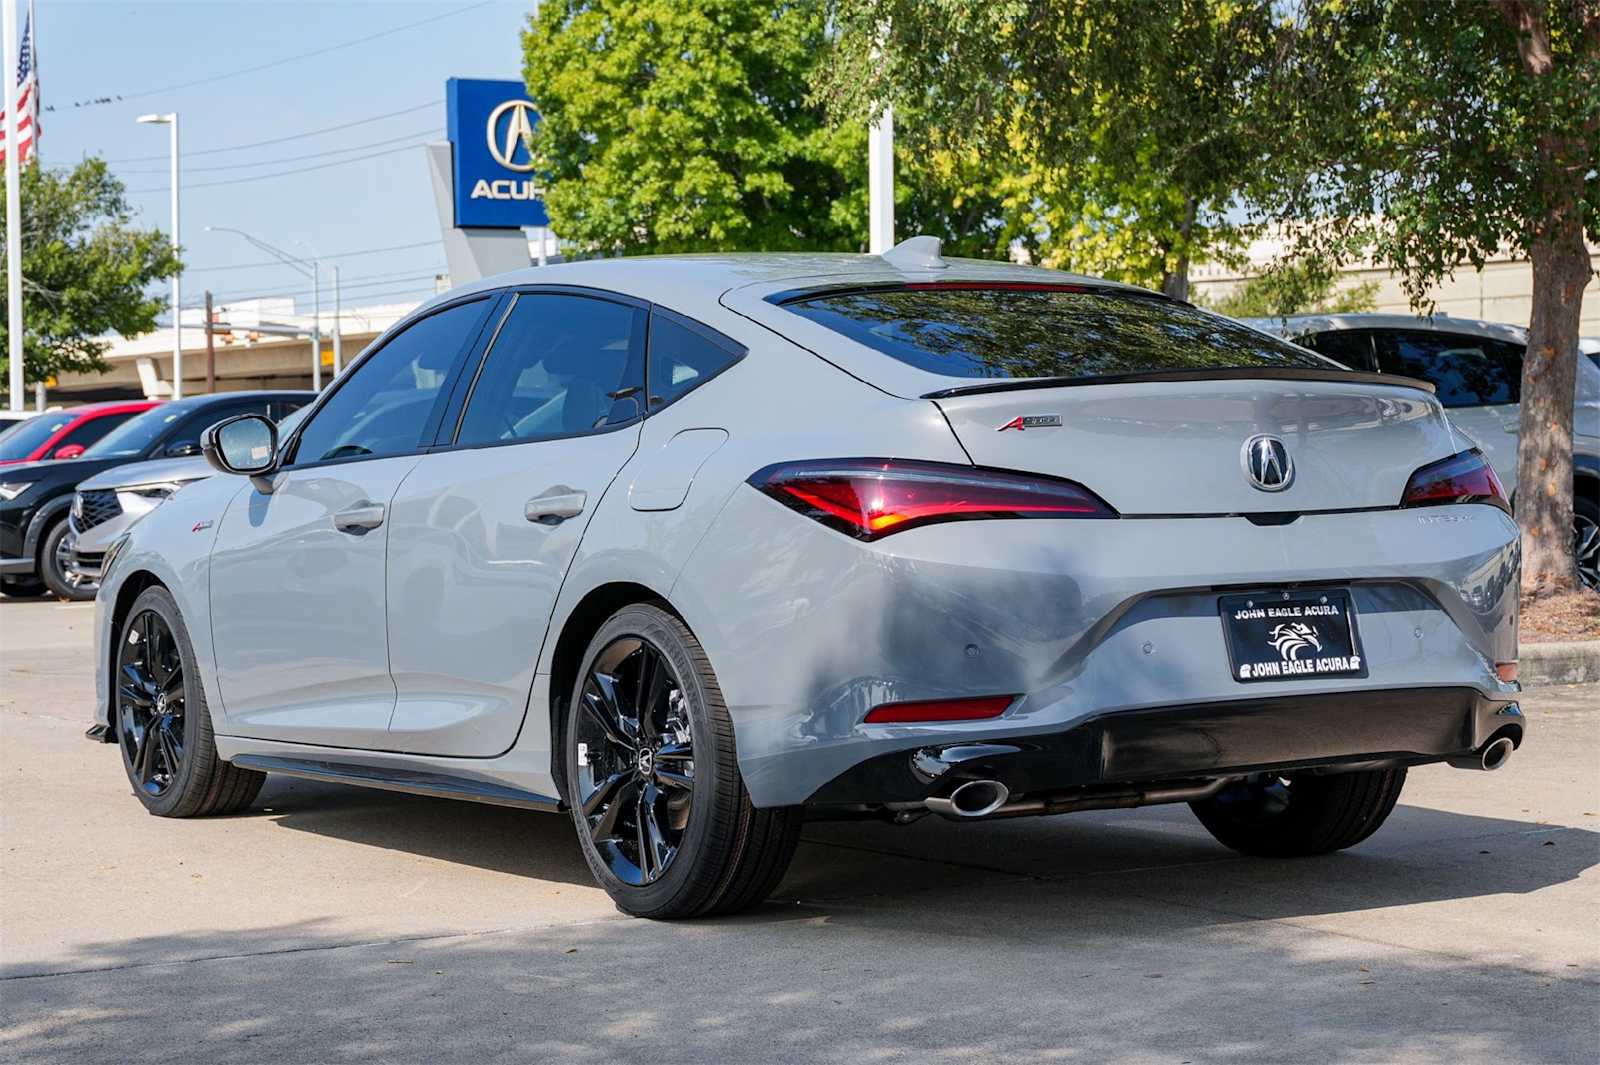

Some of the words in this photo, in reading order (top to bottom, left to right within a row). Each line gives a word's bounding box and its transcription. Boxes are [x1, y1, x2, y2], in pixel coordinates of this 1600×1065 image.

[1235, 608, 1266, 620] JOHN
[1269, 607, 1302, 617] EAGLE
[1304, 605, 1339, 616] ACURA
[1252, 661, 1281, 677] JOHN
[1281, 658, 1315, 675] EAGLE
[1316, 656, 1350, 673] ACURA
